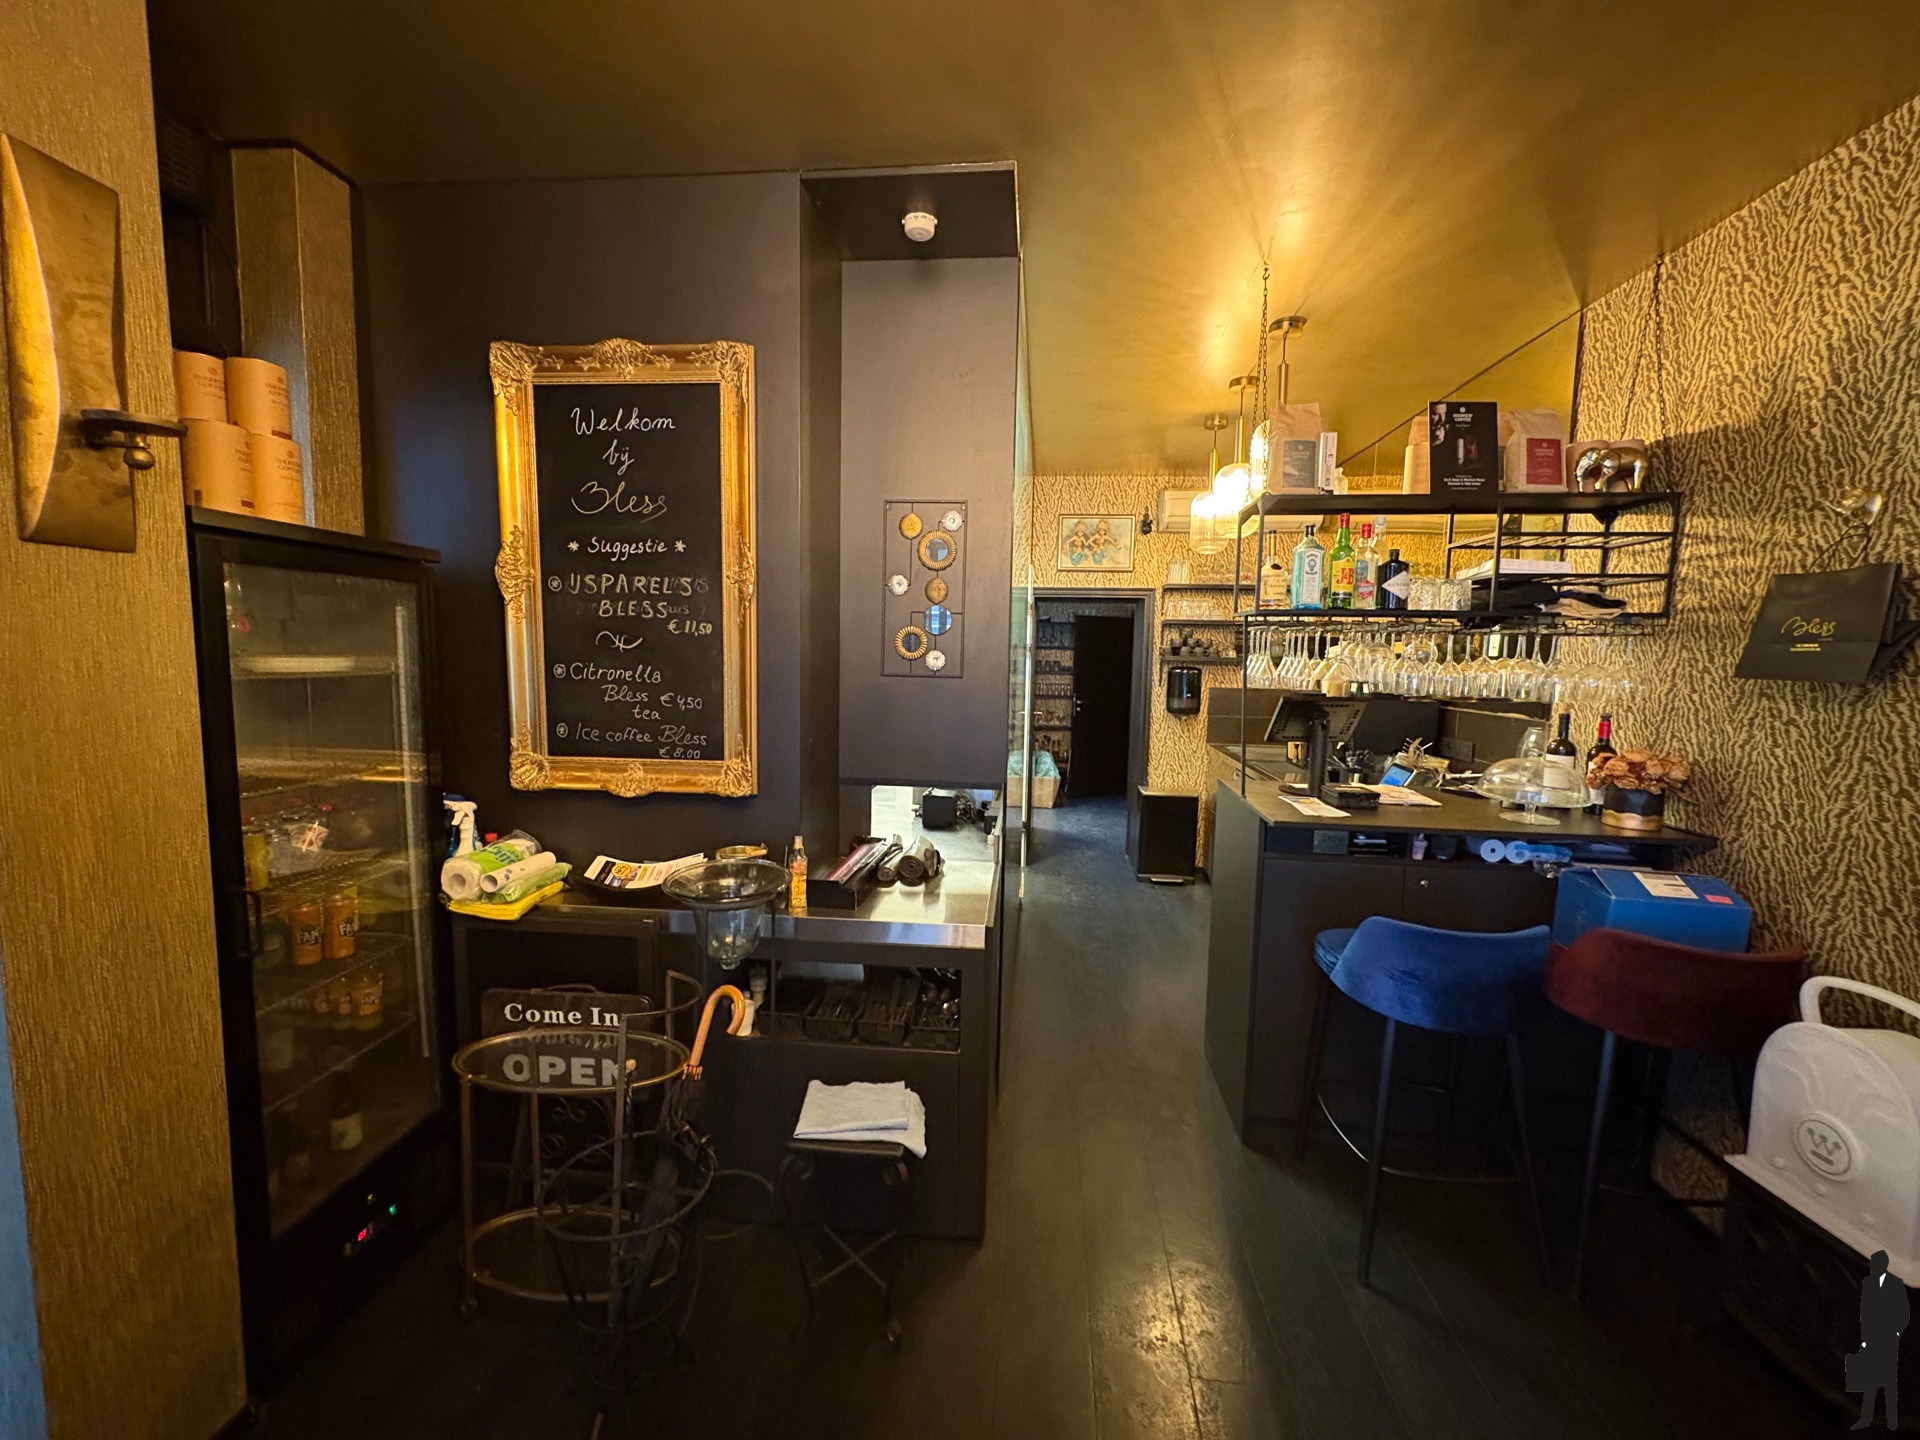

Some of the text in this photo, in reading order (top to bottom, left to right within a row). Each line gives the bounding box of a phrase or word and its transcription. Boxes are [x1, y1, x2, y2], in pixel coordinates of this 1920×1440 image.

[571, 407, 675, 435] Welkom
[570, 481, 668, 523] Bless
[587, 537, 668, 561] Suggestie
[599, 600, 668, 618] BLESS
[1781, 616, 1837, 637] Bless
[570, 662, 662, 684] Citronella
[601, 684, 649, 703] Bless
[632, 704, 661, 720] tea
[576, 723, 707, 746] Ice coffee Bless
[504, 1003, 620, 1027] Come In
